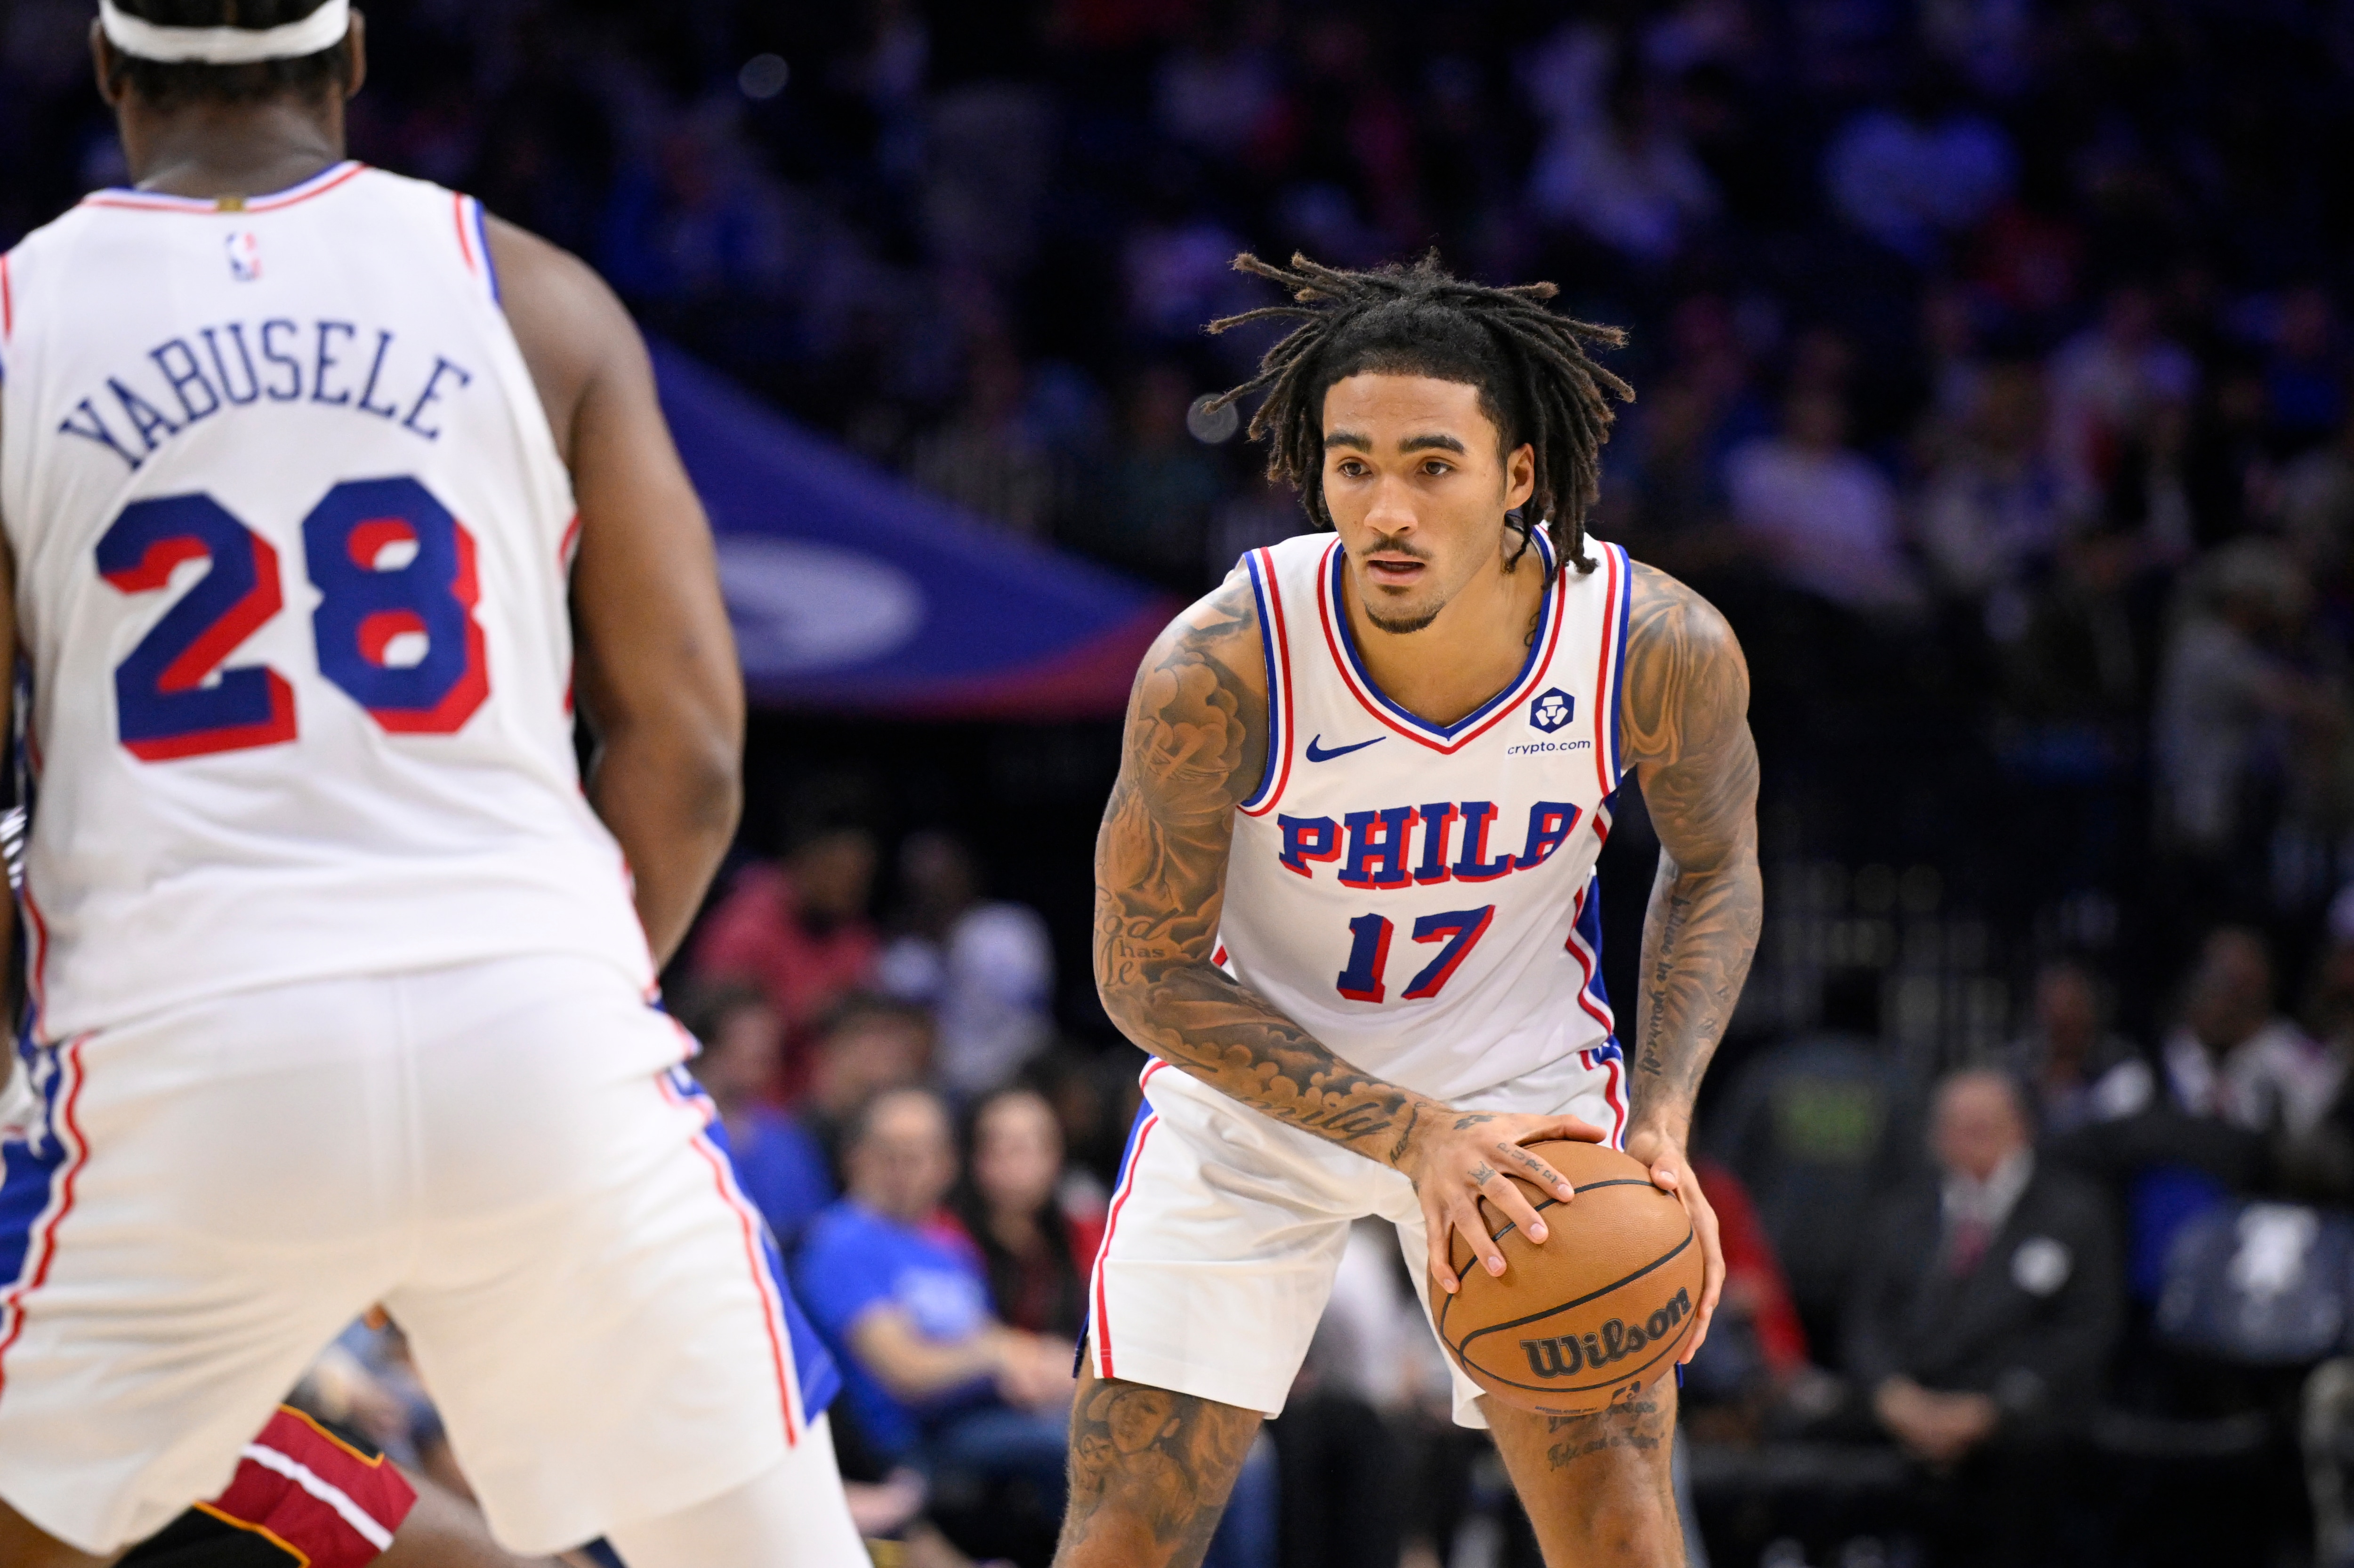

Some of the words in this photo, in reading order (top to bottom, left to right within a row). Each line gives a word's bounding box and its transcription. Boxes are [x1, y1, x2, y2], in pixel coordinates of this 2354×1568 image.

[58, 319, 473, 471] YABUSELE
[95, 475, 490, 763] 28
[1508, 740, 1591, 754] crypto.com
[1337, 904, 1496, 1004] 17
[1496, 1142, 1558, 1183] PURE
[1520, 1287, 1693, 1379] Wilson
